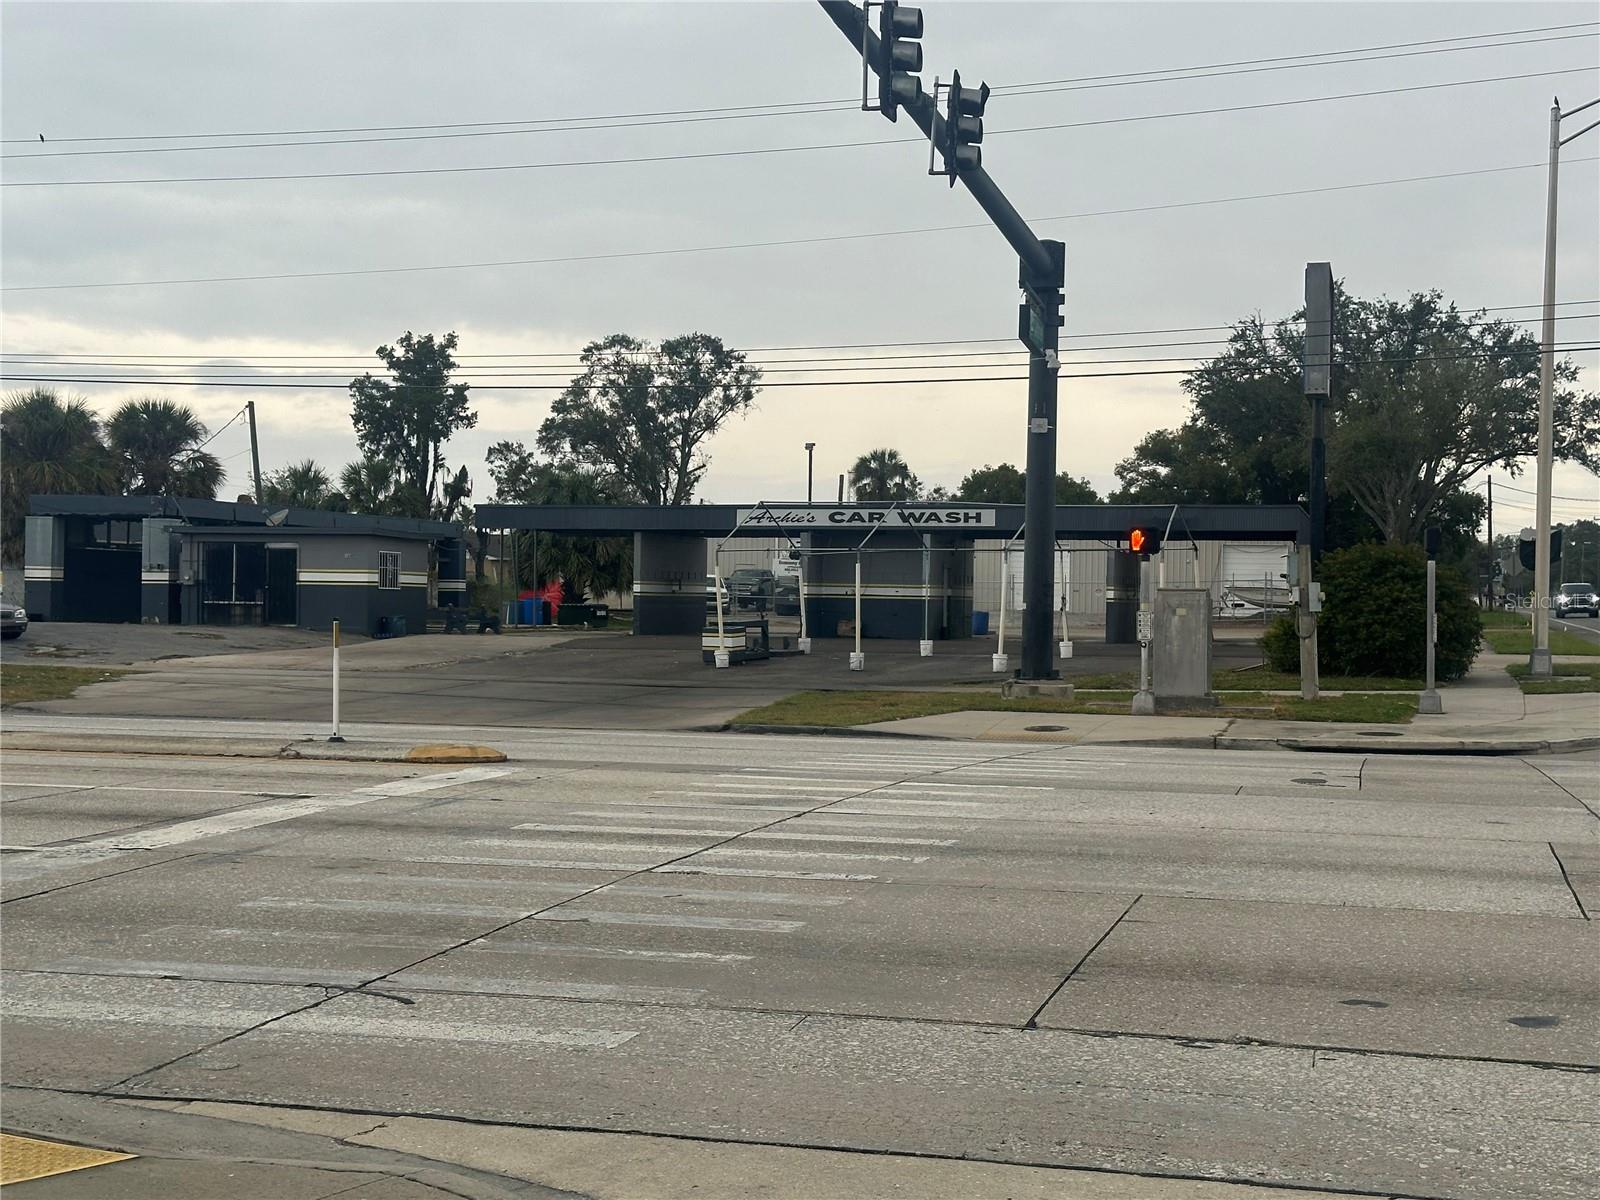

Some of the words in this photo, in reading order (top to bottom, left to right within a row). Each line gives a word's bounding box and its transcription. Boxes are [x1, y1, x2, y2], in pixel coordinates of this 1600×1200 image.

[744, 510, 816, 525] Archie's
[828, 511, 888, 524] CAR
[897, 511, 982, 524] WASH
